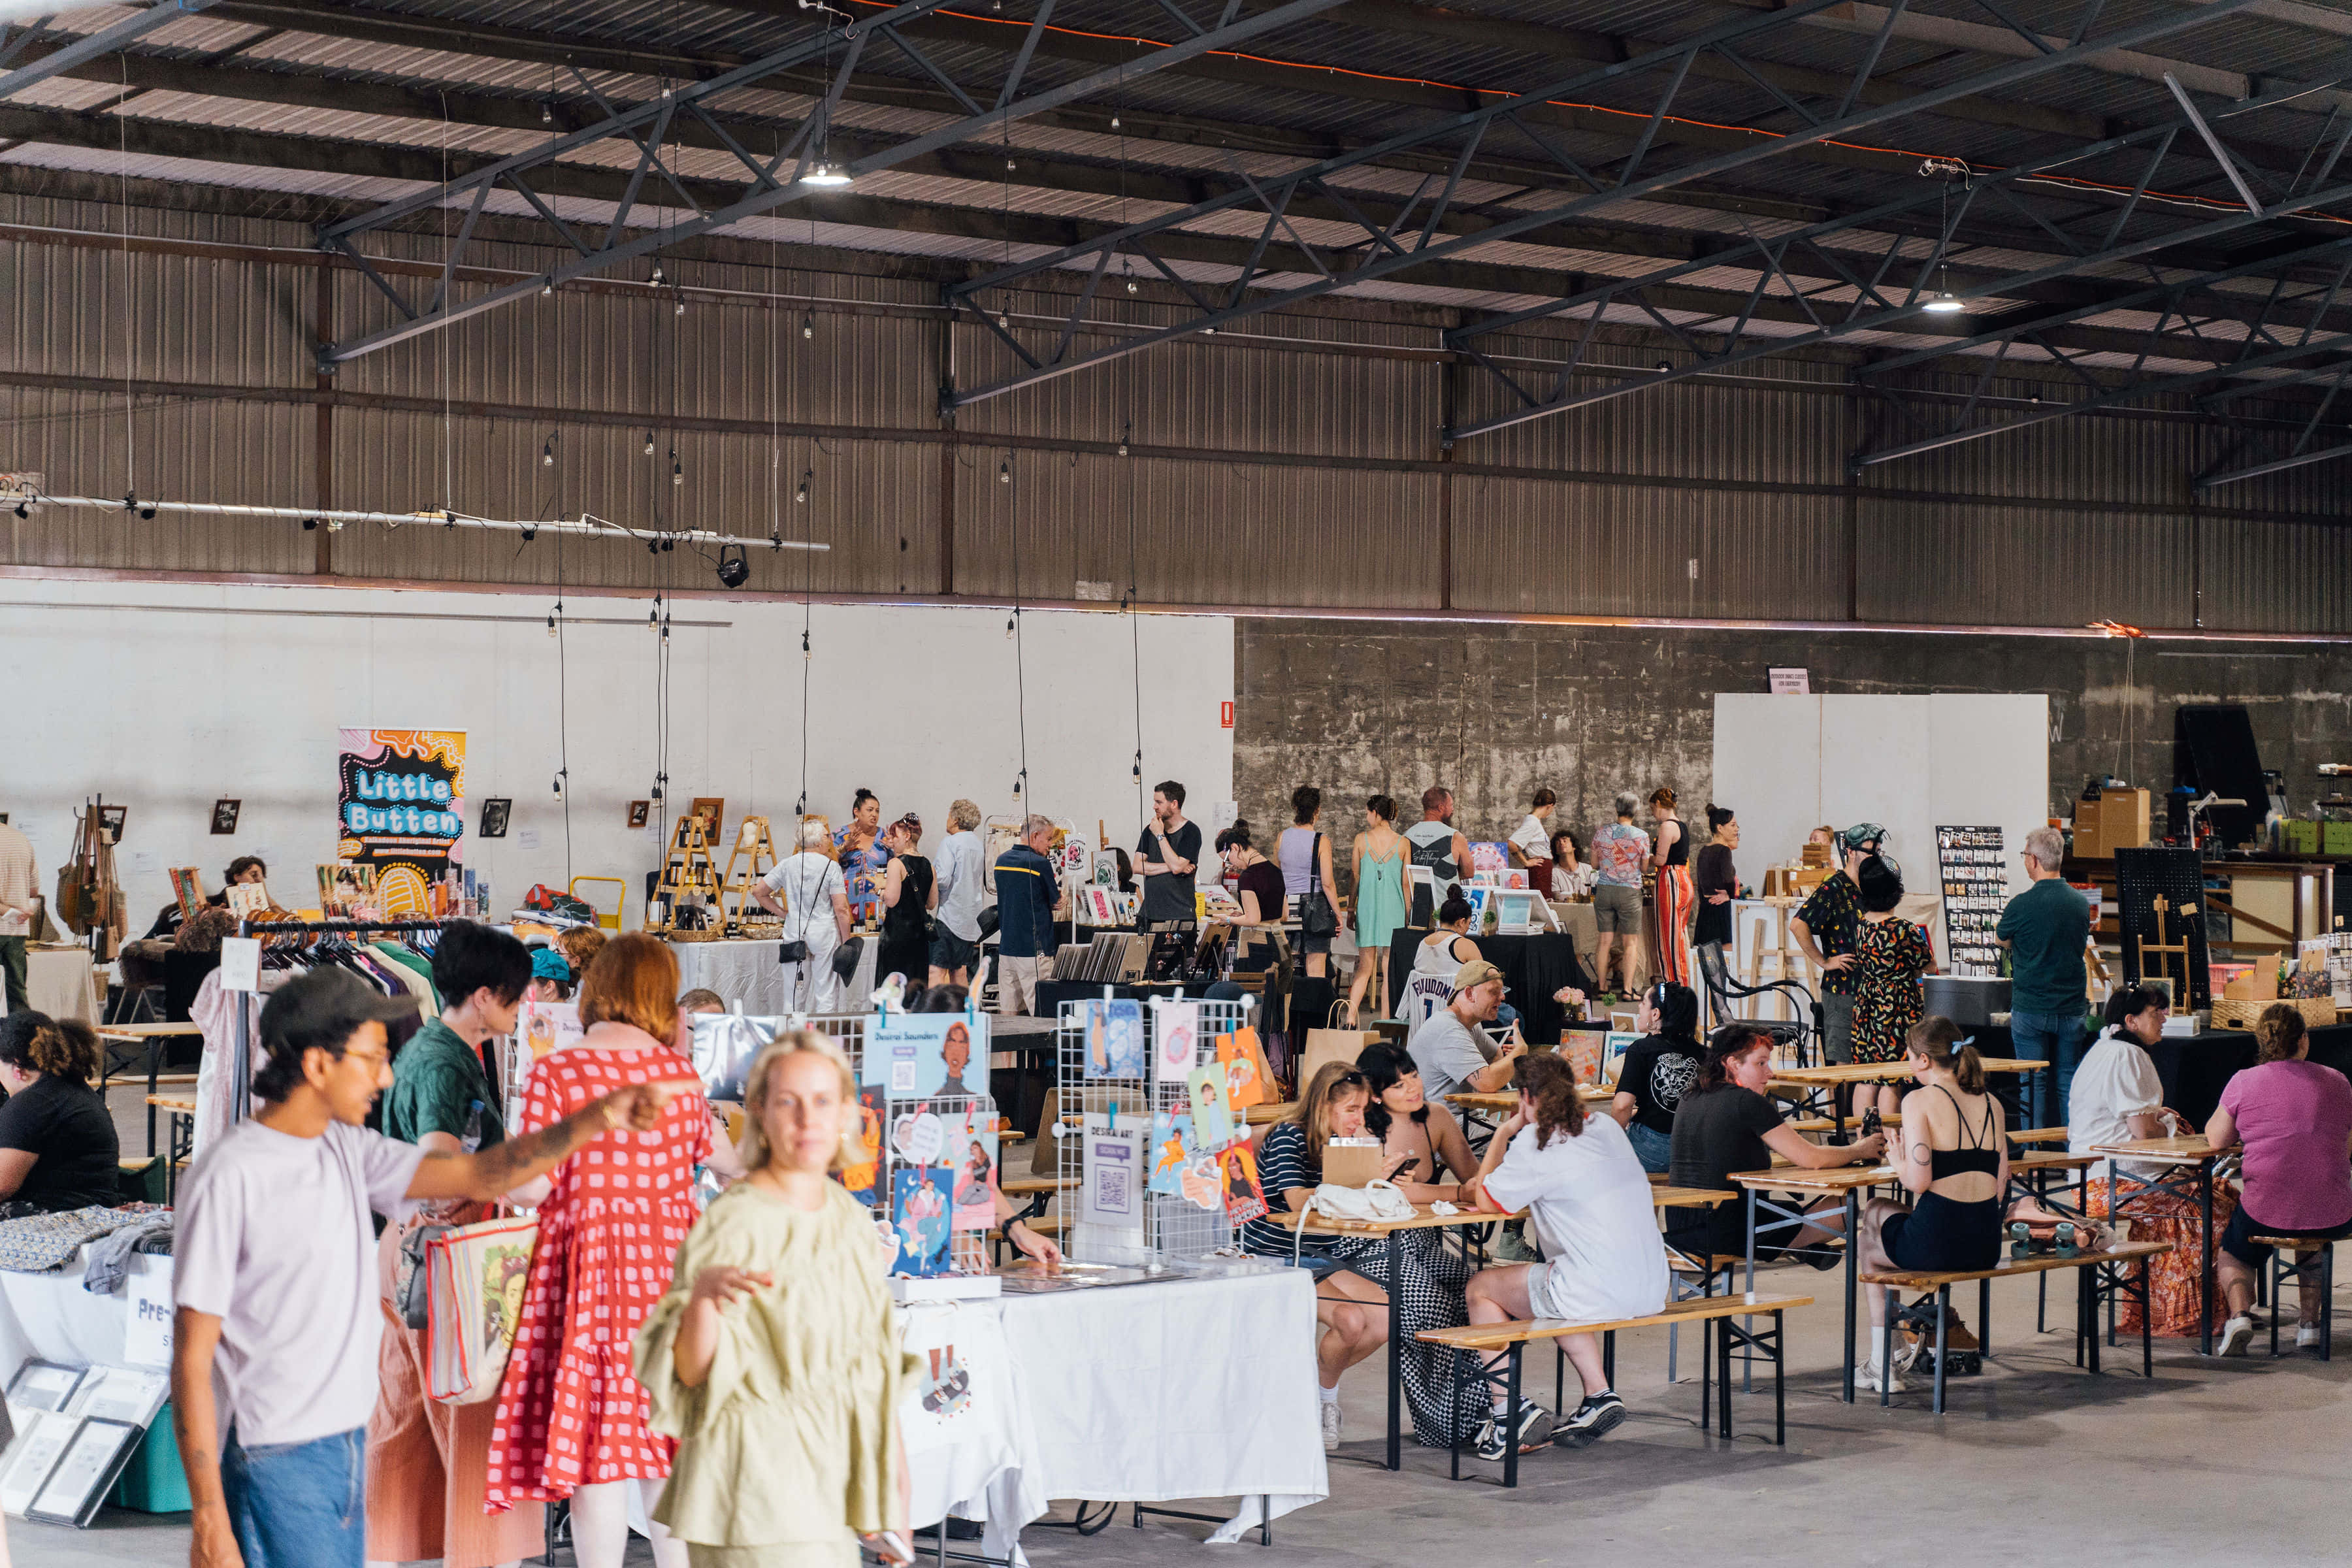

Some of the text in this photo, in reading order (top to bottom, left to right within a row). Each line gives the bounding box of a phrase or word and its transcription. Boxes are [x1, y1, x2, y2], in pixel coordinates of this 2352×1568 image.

[359, 772, 449, 799] Little
[351, 806, 456, 832] Butten
[1120, 1130, 1134, 1139] ART
